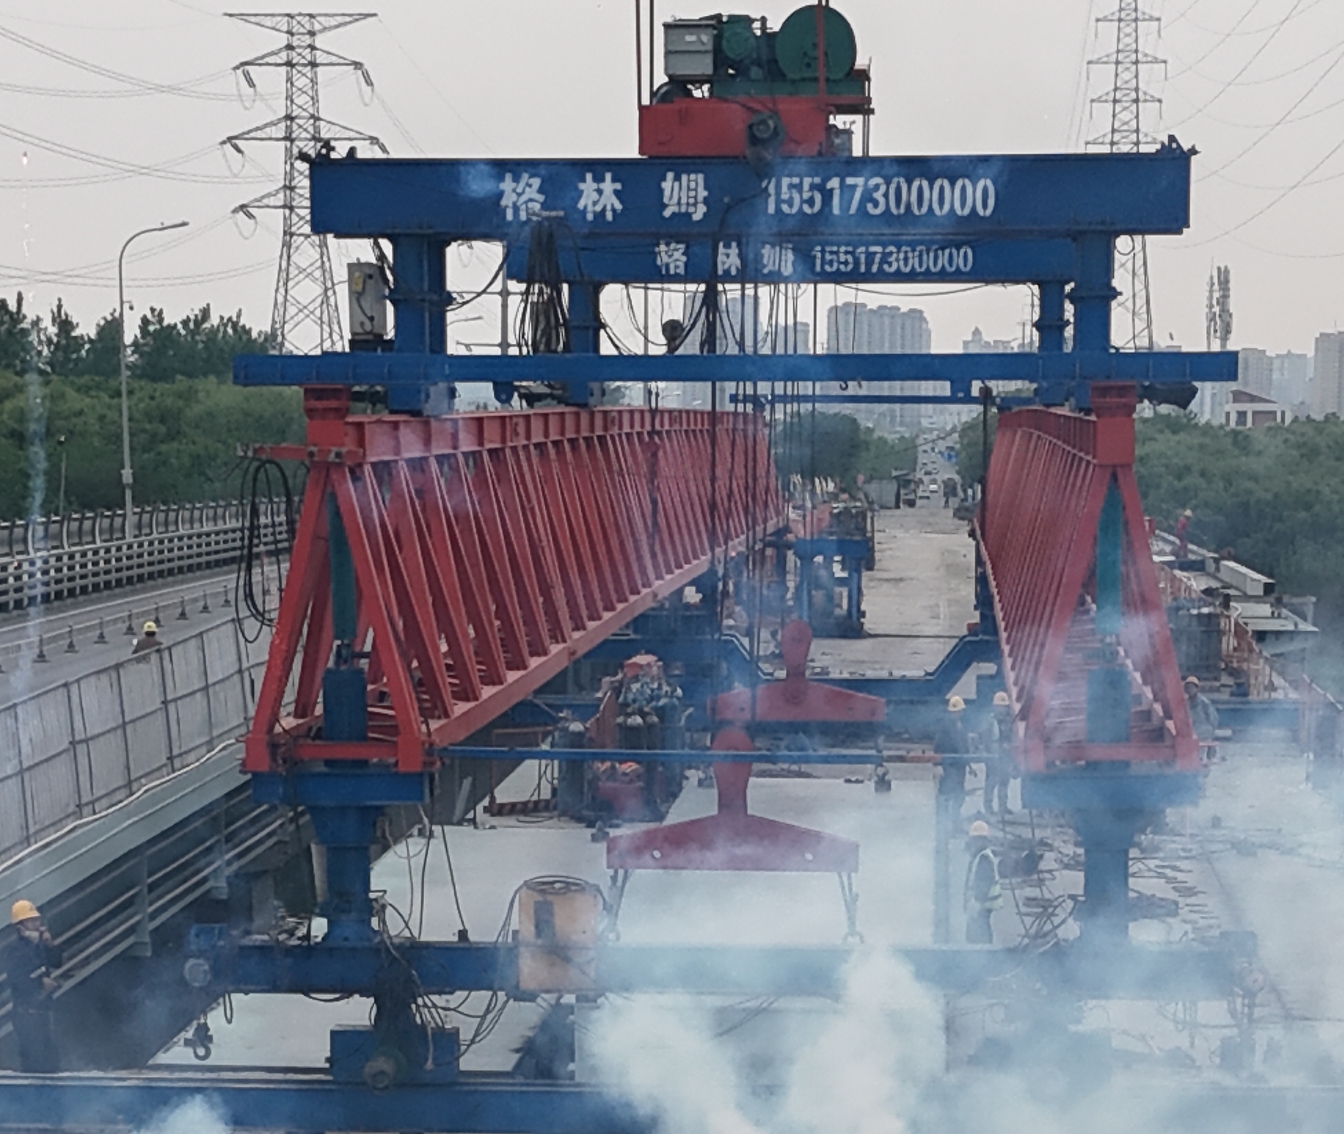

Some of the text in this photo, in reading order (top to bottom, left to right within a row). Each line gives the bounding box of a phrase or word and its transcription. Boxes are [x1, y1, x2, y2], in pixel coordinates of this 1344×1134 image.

[499, 172, 996, 222] 格林姆 15517300000
[812, 245, 974, 273] 15517300000
